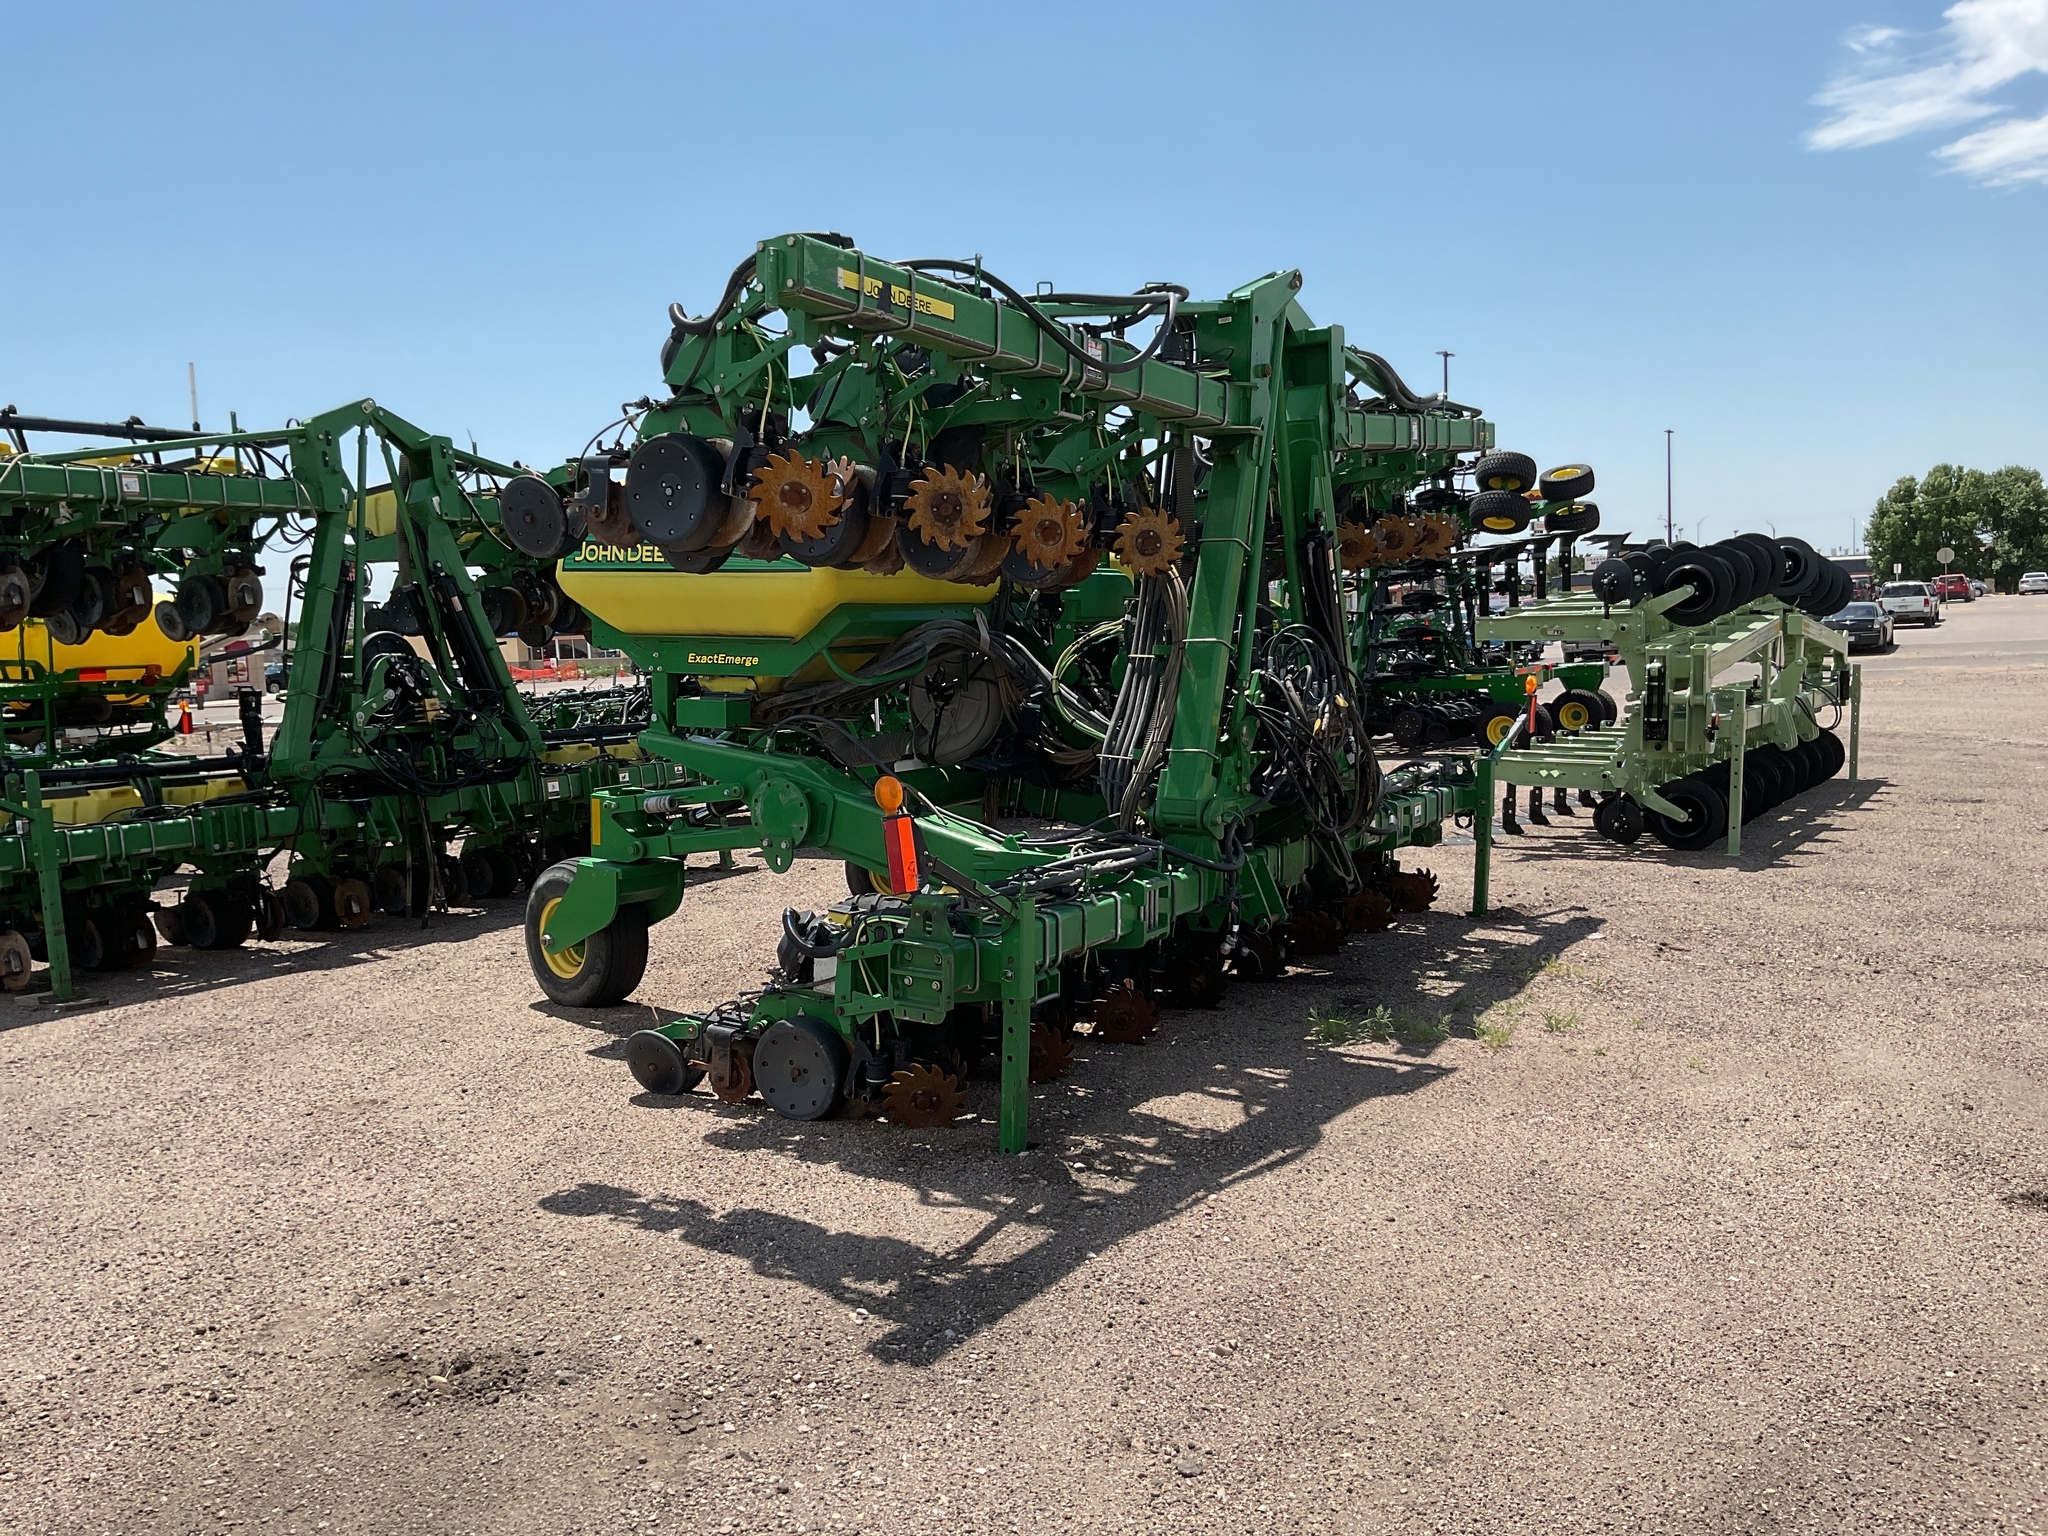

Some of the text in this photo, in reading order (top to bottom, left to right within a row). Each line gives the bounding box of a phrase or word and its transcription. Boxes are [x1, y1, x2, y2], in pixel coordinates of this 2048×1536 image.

[866, 281, 896, 302] JON
[574, 541, 665, 562] JOHN DEE
[687, 652, 759, 667] ExactEmerge
